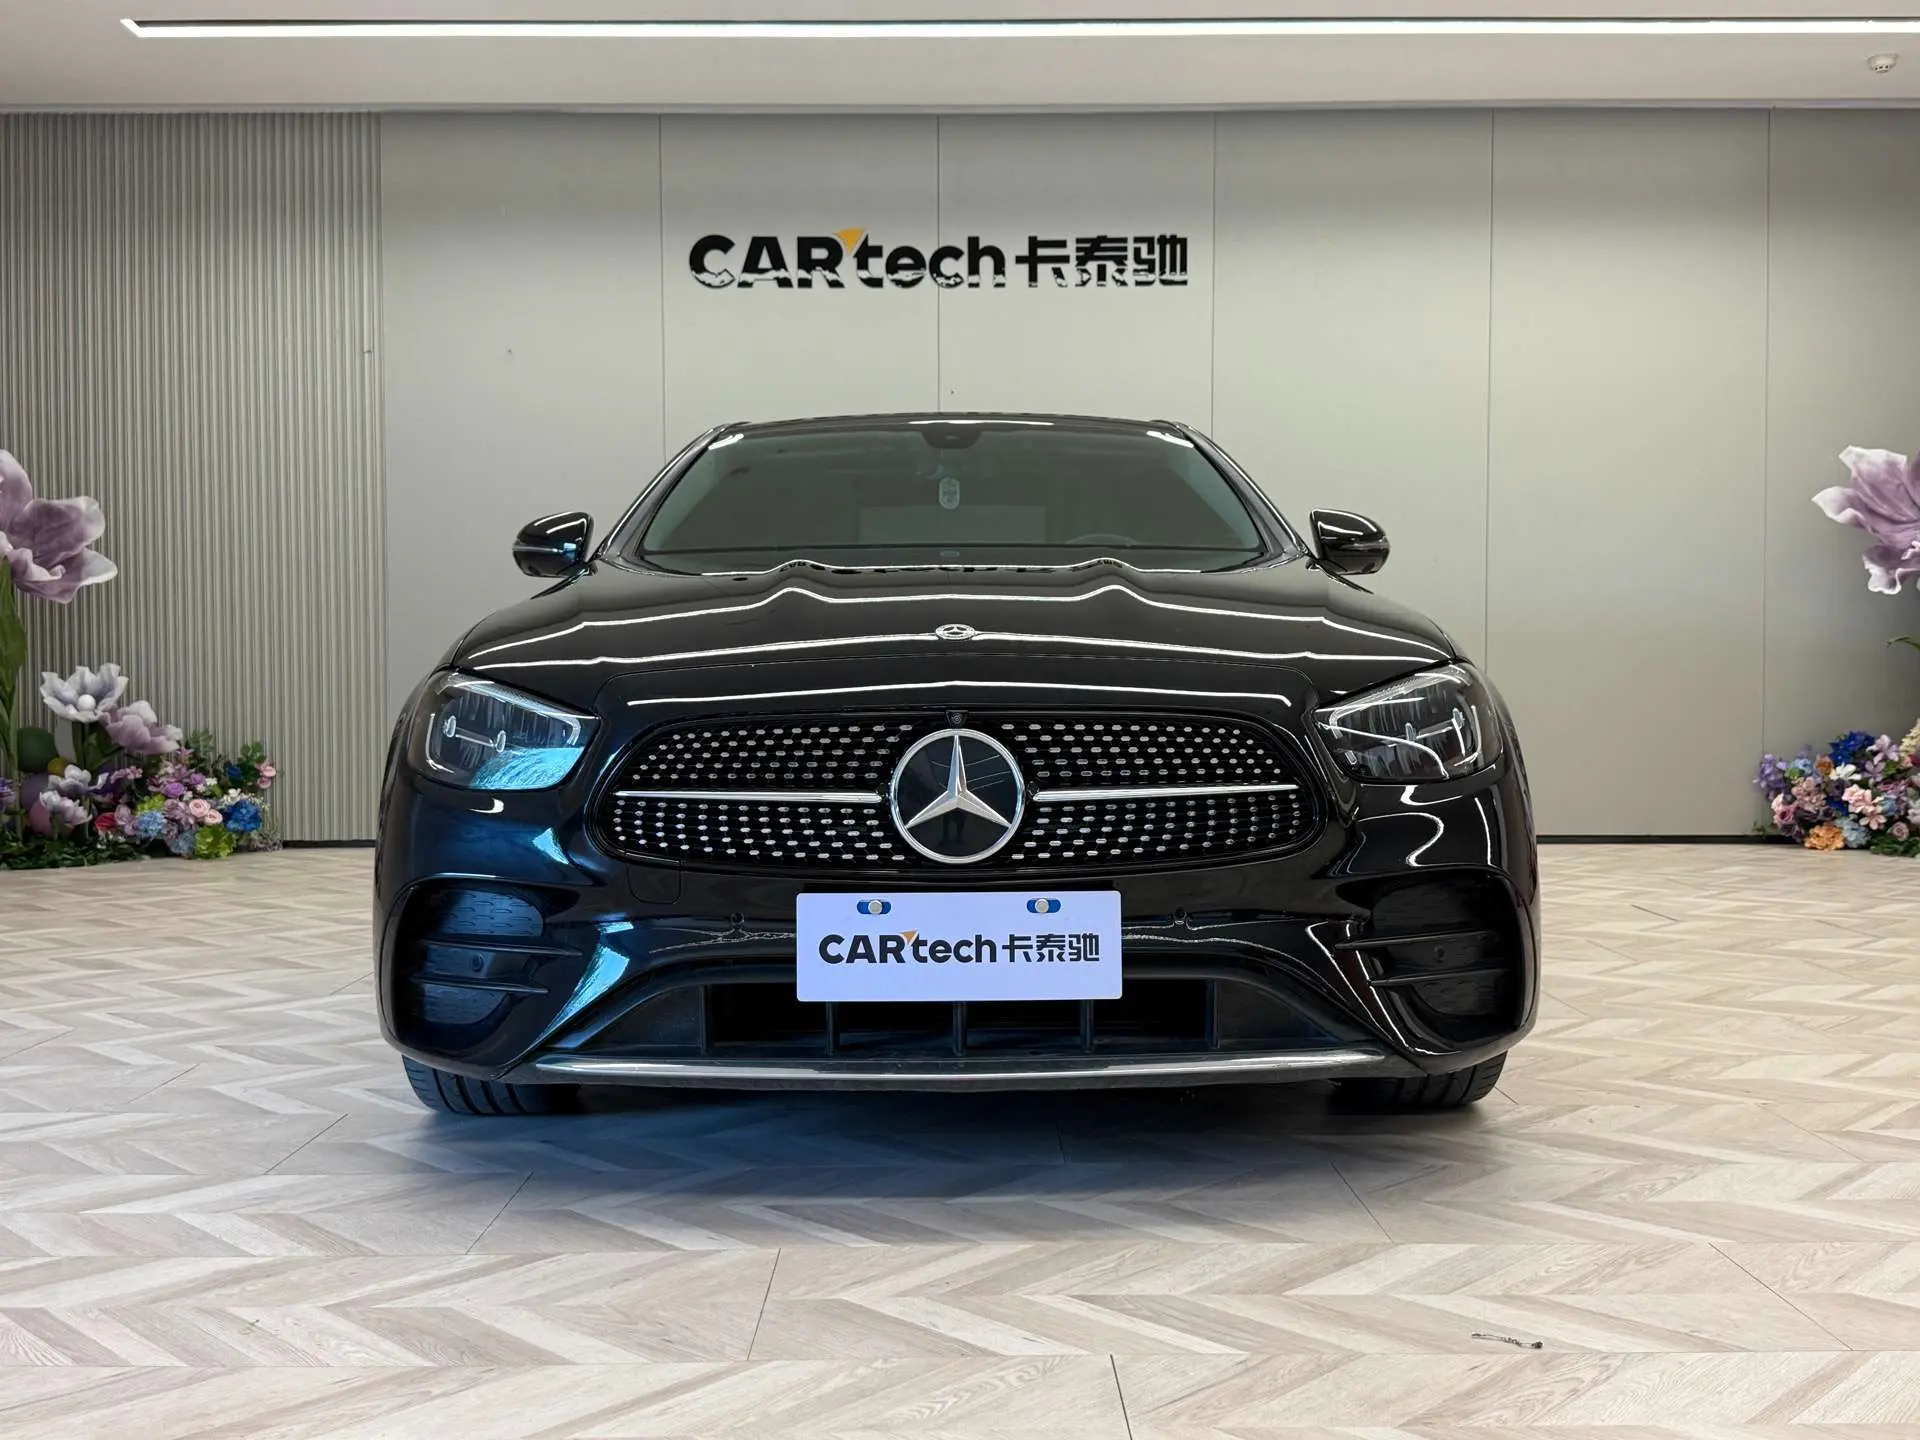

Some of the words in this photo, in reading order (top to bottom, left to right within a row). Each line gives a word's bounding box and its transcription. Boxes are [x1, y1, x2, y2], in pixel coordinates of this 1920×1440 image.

[688, 231, 1006, 289] CARtech
[1015, 234, 1188, 288] 卡泰驰
[818, 932, 997, 964] CARtech
[1002, 933, 1100, 962] 卡泰驰
